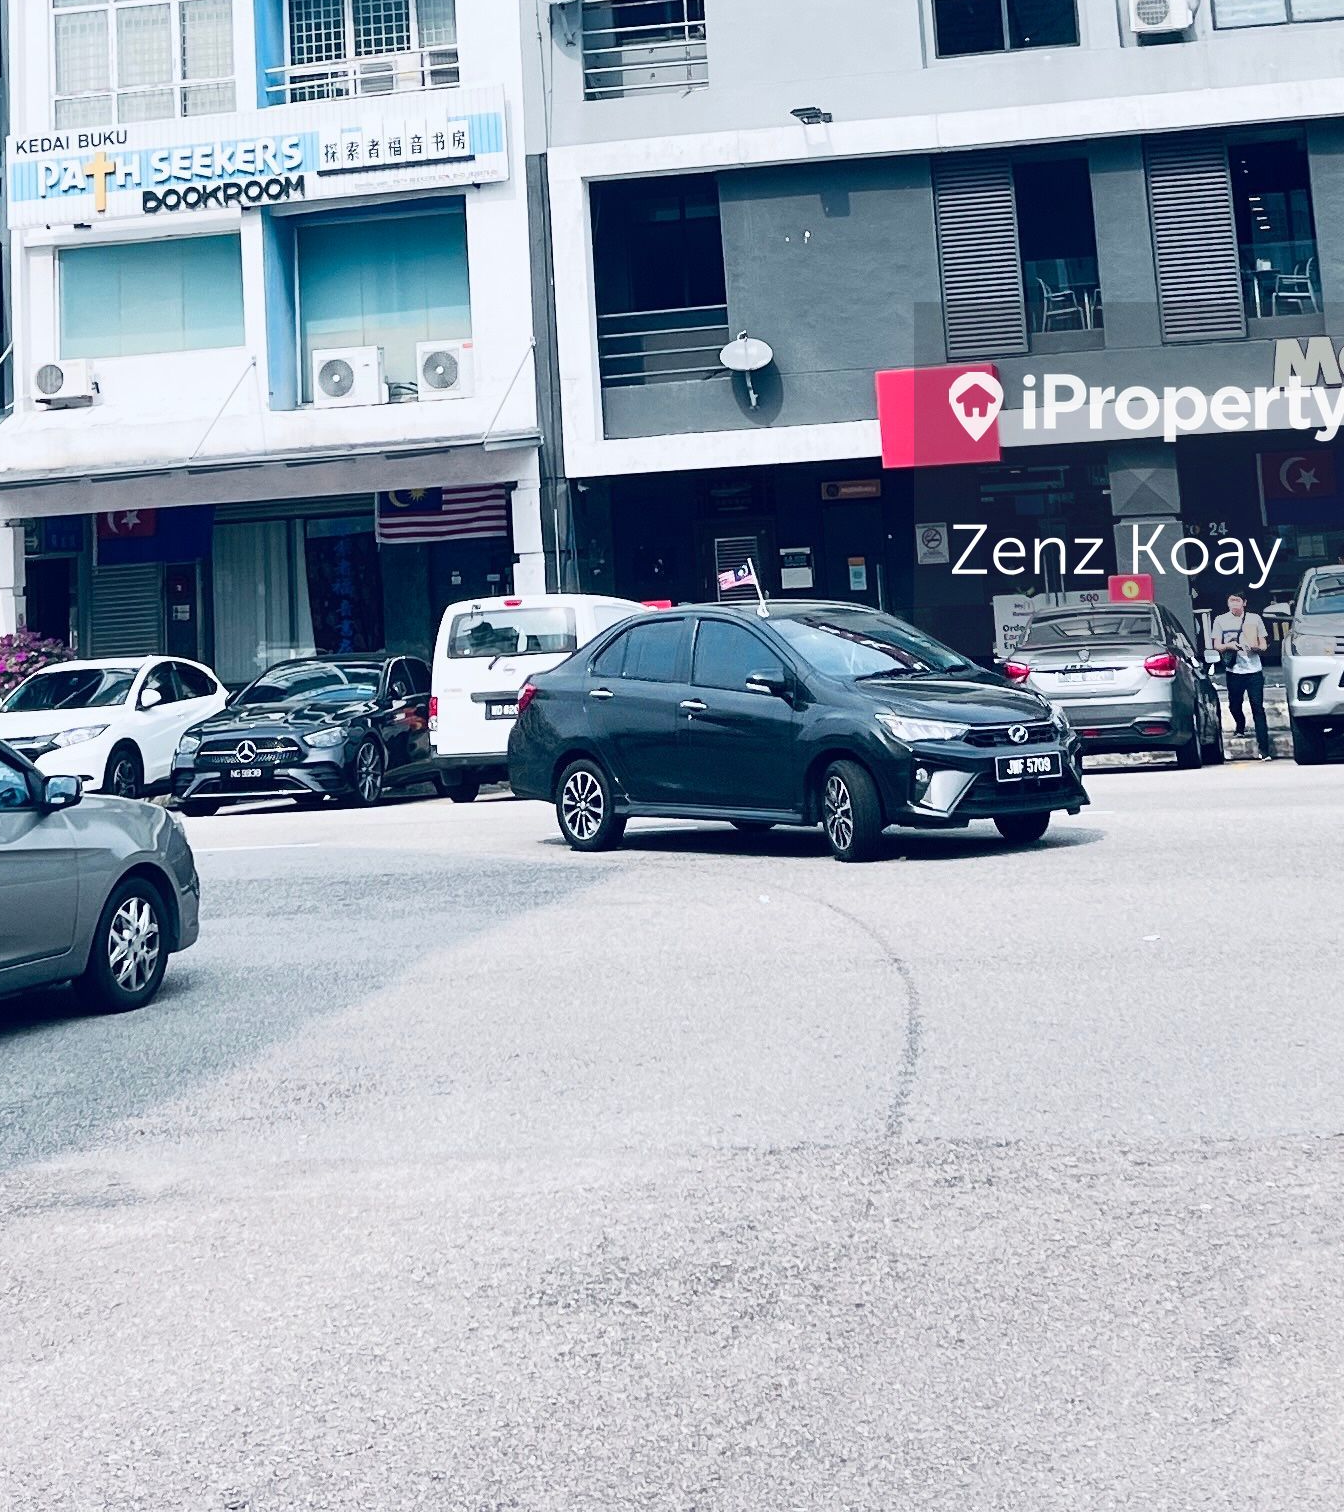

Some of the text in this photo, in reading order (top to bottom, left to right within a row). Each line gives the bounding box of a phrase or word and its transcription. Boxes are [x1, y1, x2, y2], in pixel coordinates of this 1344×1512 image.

[16, 129, 128, 155] KEDAI BUKU
[38, 136, 304, 213] PATH SEEKERS
